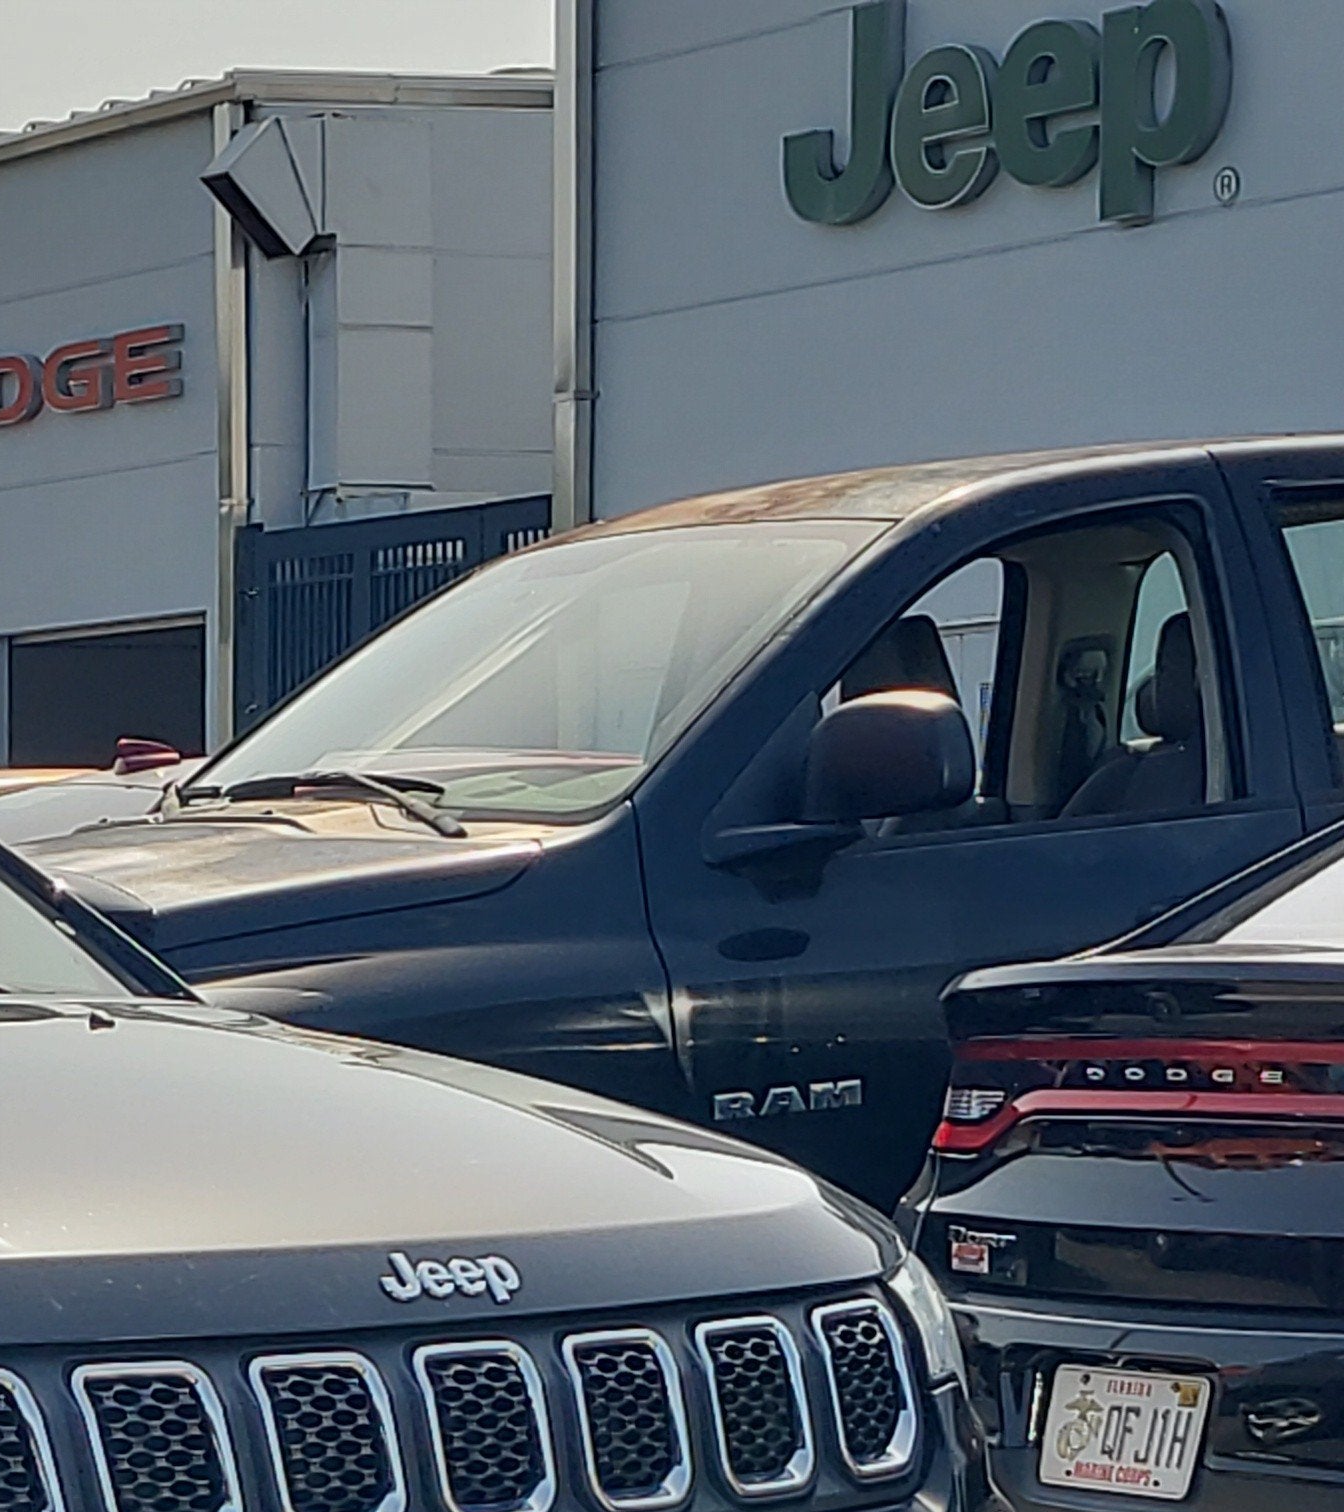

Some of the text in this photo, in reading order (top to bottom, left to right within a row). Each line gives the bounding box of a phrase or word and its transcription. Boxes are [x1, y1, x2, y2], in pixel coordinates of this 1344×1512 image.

[783, 0, 1233, 226] Jeep
[1085, 1066, 1284, 1084] DODGE
[713, 1078, 862, 1121] RAM
[379, 1252, 521, 1304] Jeep
